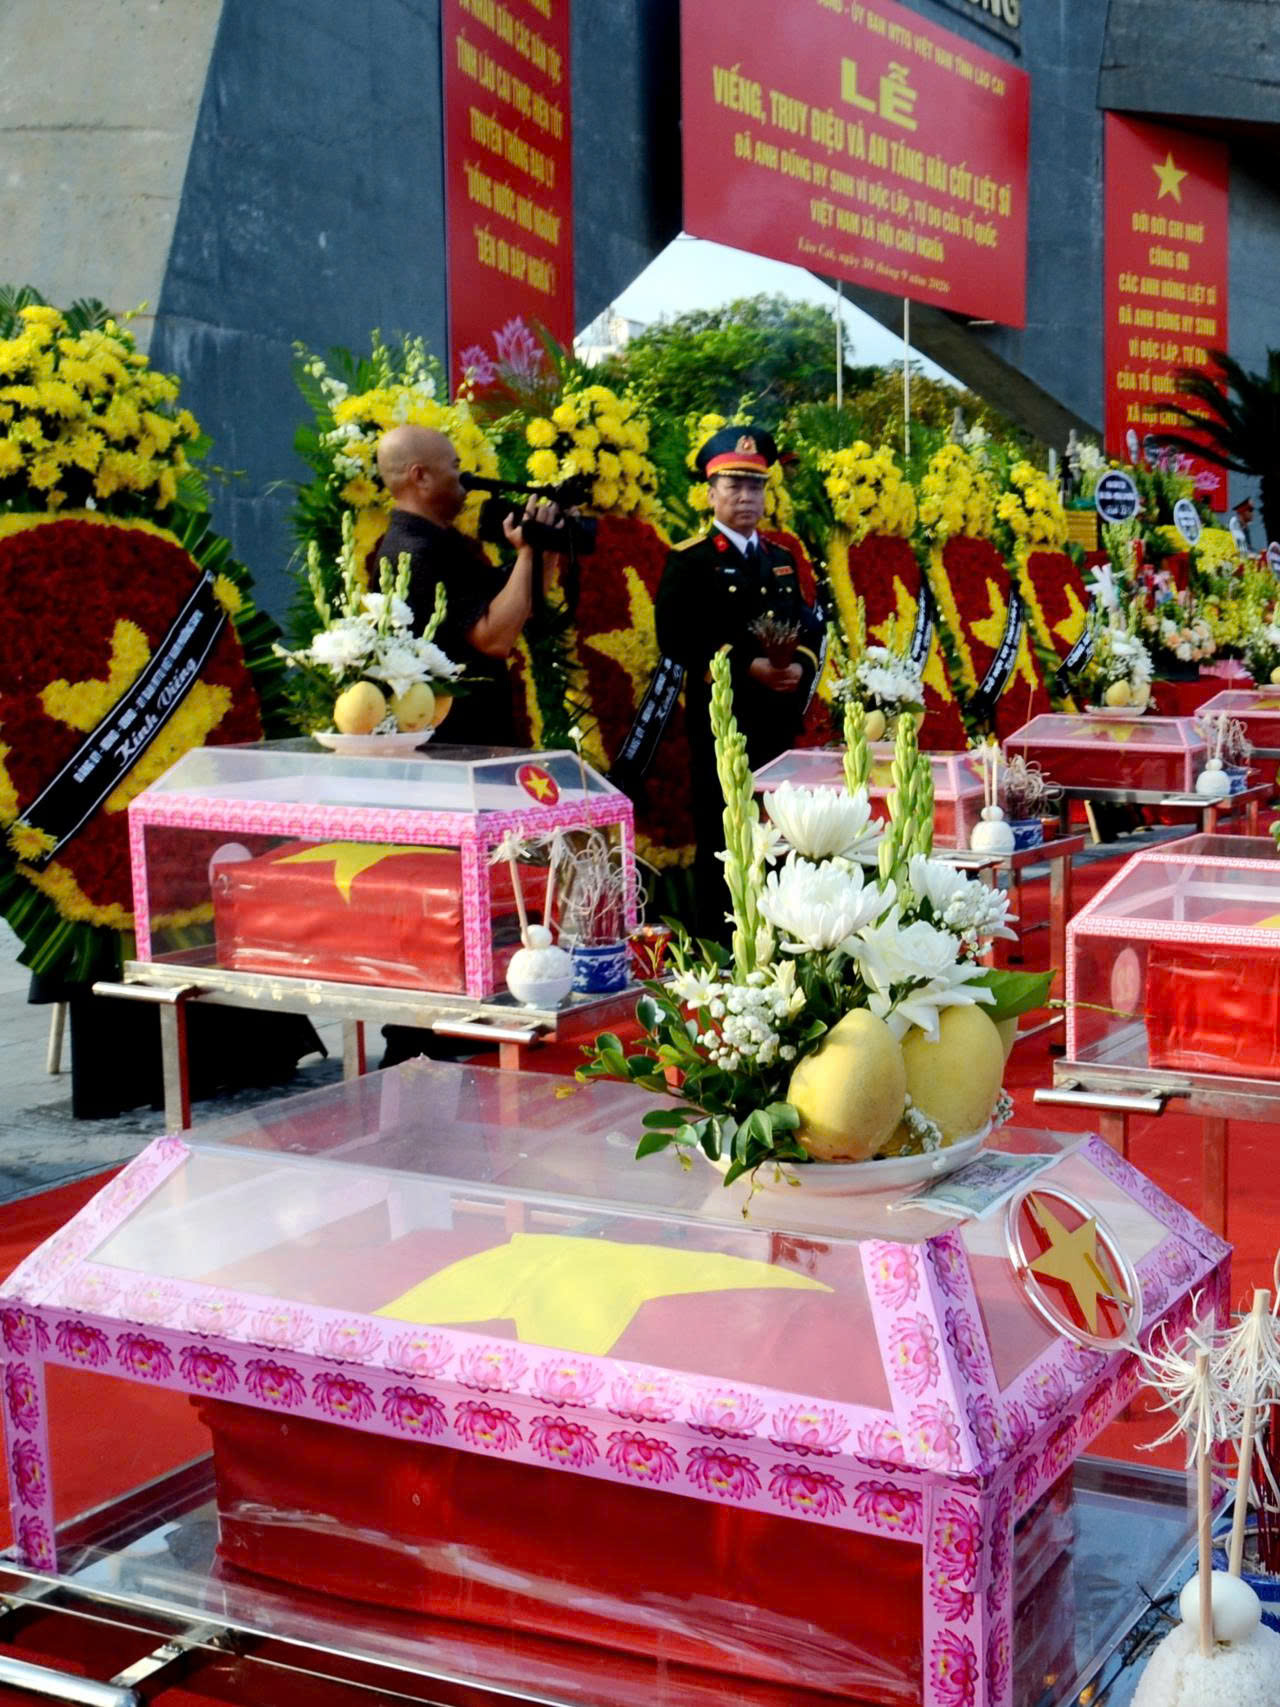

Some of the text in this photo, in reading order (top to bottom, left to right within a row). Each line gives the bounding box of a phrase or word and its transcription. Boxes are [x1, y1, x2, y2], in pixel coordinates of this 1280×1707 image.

[840, 56, 918, 132] LỄ
[713, 63, 766, 126] VIẾNG,
[769, 89, 809, 137] TRUY
[811, 107, 845, 155] ĐIỆU
[847, 120, 866, 161] VÀ
[868, 132, 889, 169] AN
[890, 139, 925, 184] TÁNG
[926, 154, 949, 192] HÀI
[950, 161, 972, 202] CỐT
[974, 175, 998, 215] LIỆT
[735, 130, 752, 160] ĐÃ
[754, 140, 779, 171] ANH
[813, 162, 829, 188] HY
[830, 168, 855, 198] SINH
[836, 207, 861, 236] NAM
